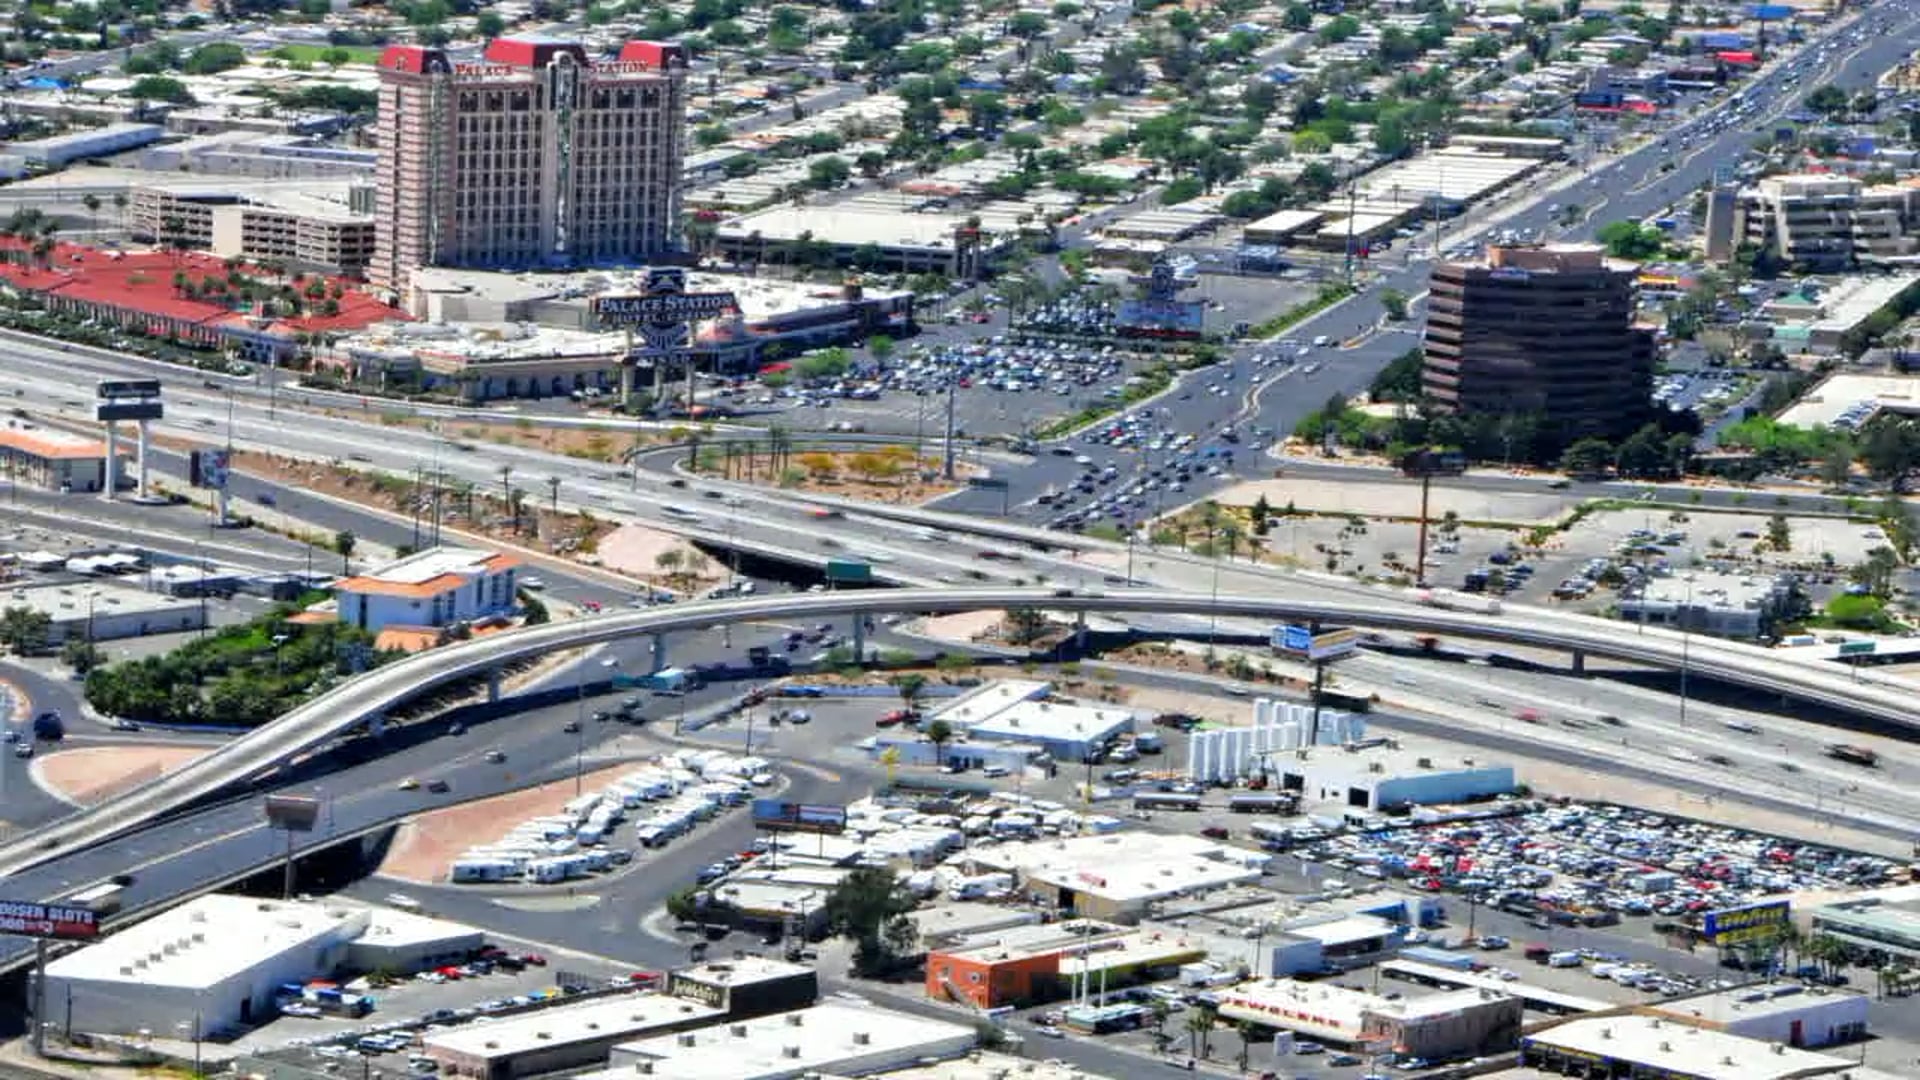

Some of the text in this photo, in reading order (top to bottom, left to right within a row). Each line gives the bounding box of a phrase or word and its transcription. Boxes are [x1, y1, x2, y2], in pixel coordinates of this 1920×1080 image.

[455, 60, 650, 76] PALACE STATION
[600, 293, 734, 313] PALACE STATION
[48, 906, 94, 925] SLOTS
[1224, 996, 1342, 1028] JEWELERS
